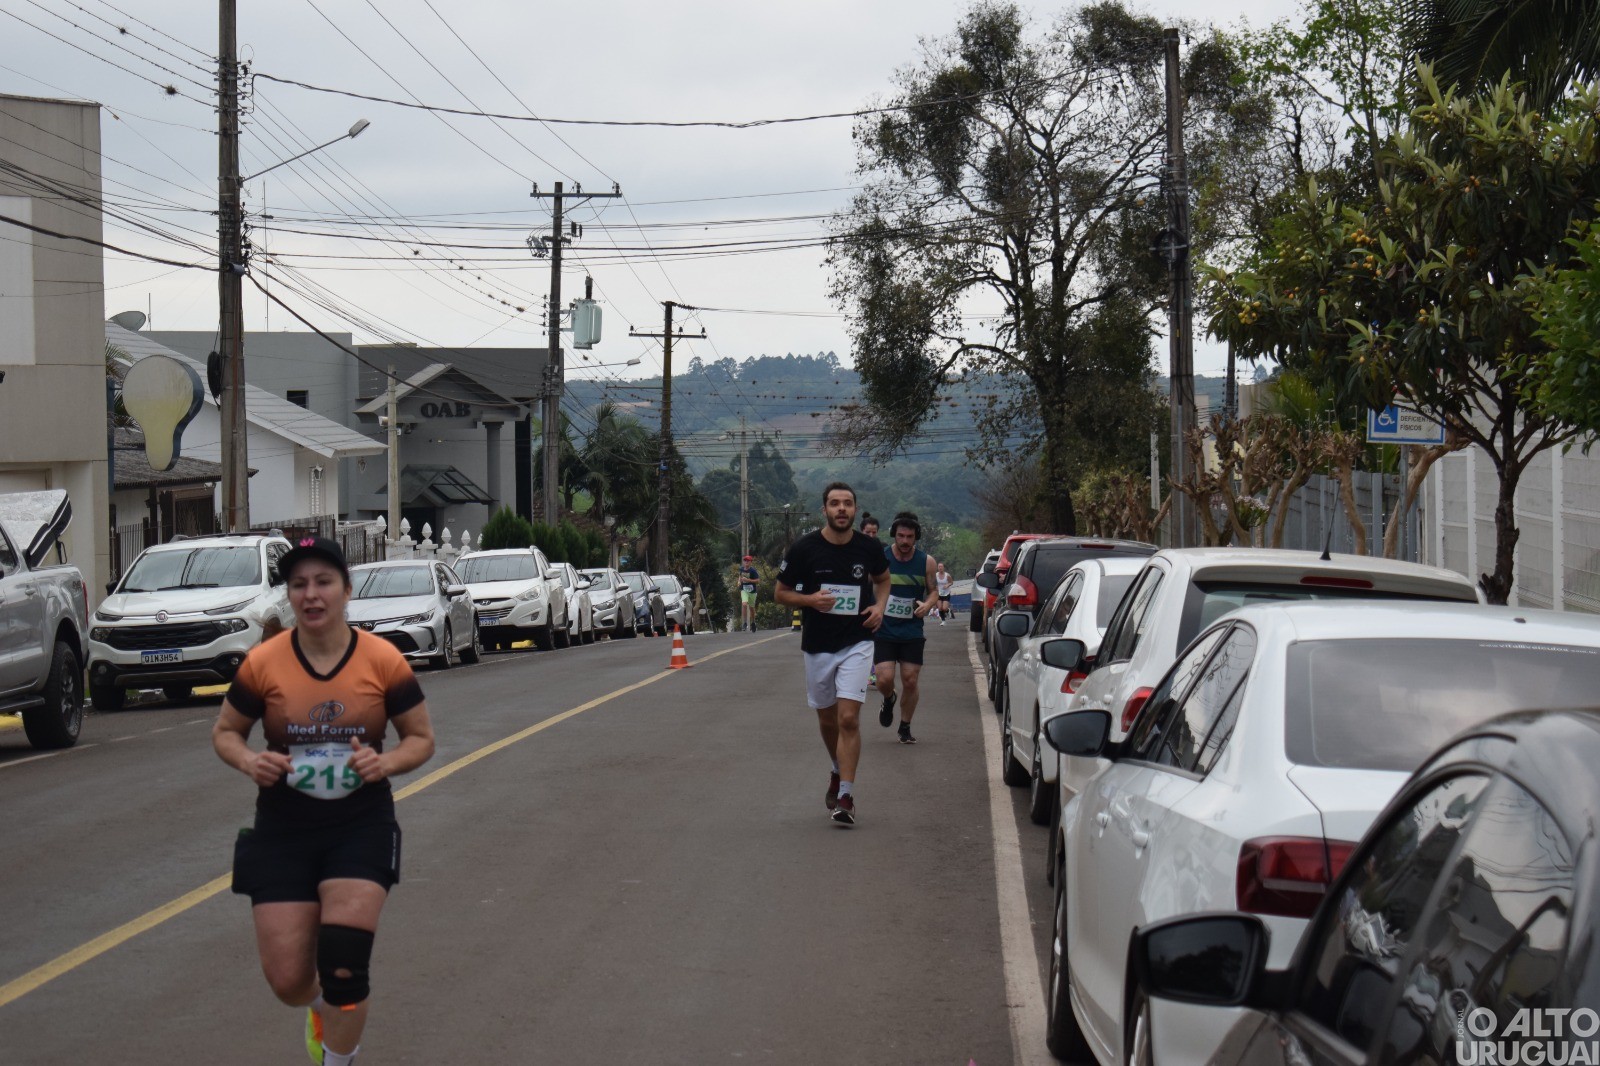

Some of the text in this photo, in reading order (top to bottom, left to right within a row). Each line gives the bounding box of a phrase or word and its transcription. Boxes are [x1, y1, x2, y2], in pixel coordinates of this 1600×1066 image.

[421, 401, 471, 418] OAB
[834, 596, 856, 611] 25
[887, 603, 912, 616] 259
[287, 724, 366, 735] Med Forma
[294, 764, 362, 791] 215
